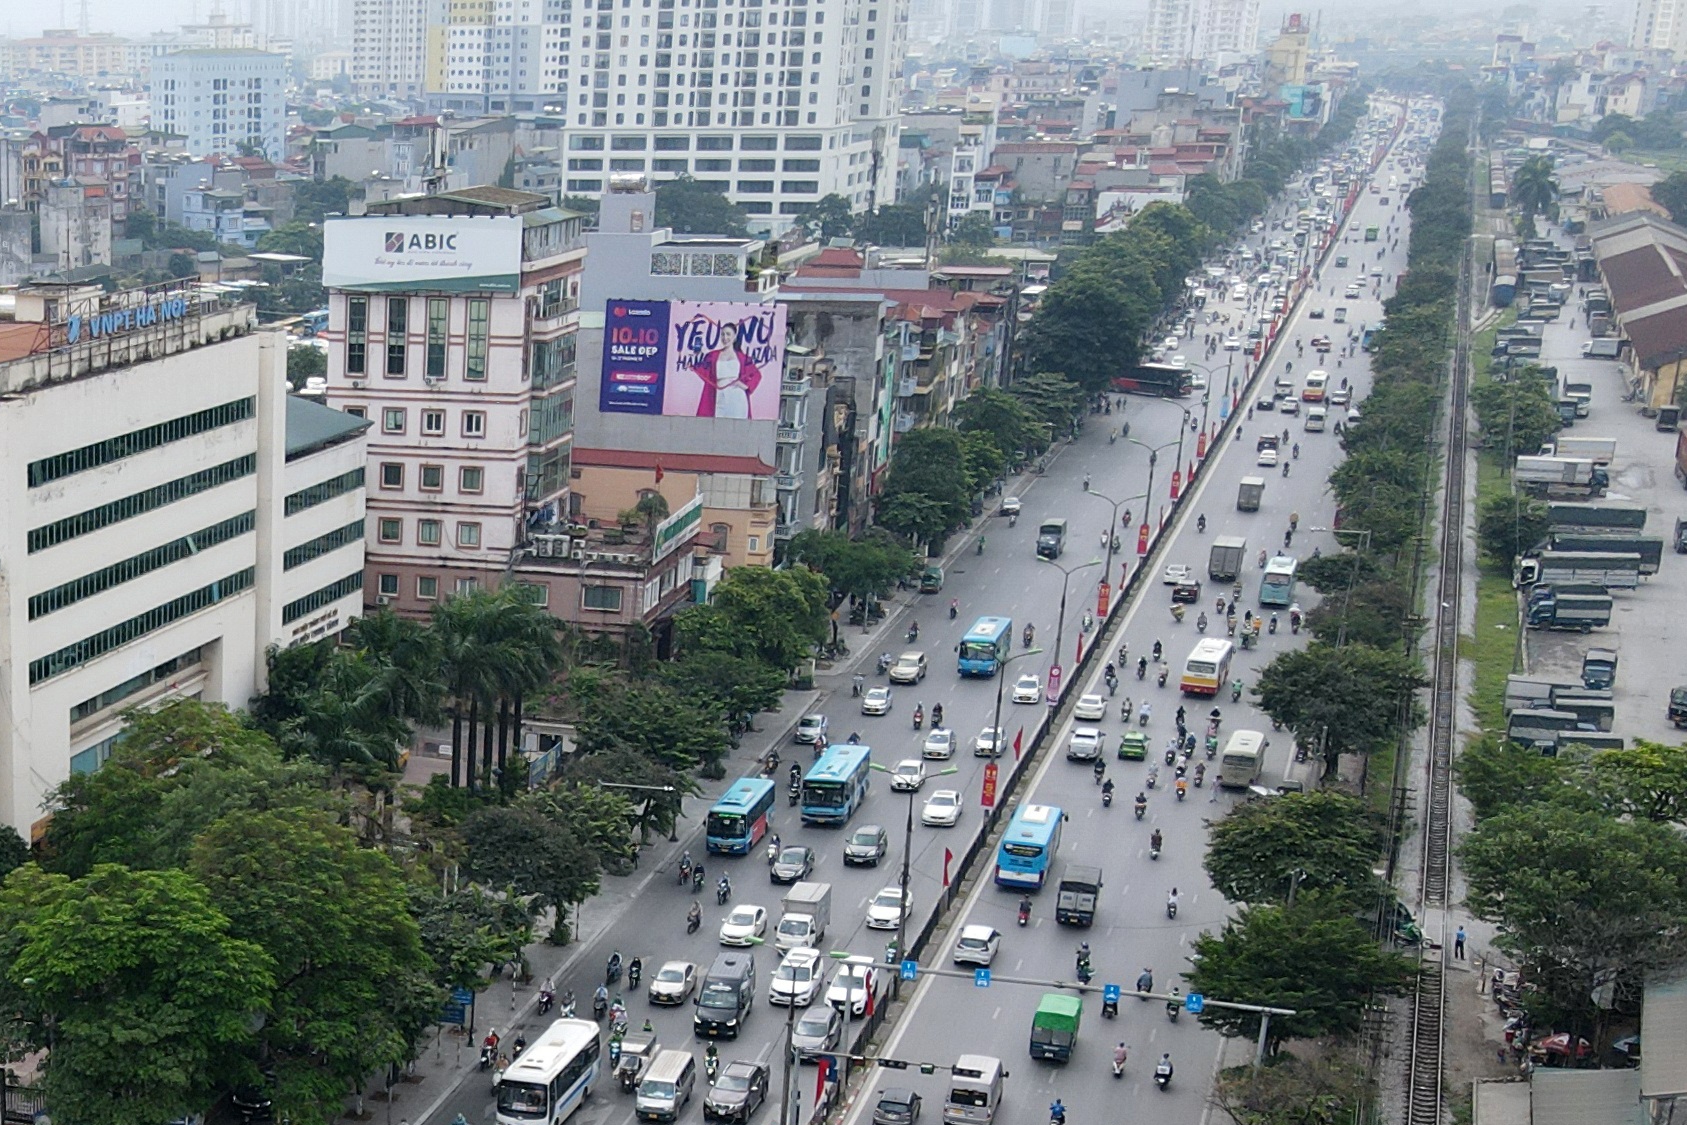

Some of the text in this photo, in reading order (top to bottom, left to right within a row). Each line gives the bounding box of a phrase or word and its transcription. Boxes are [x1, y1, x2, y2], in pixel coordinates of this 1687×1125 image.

[408, 233, 457, 250] ABIC
[90, 310, 130, 338] VNPT
[675, 311, 775, 353] YÊU NỮ
[611, 345, 637, 355] SALE
